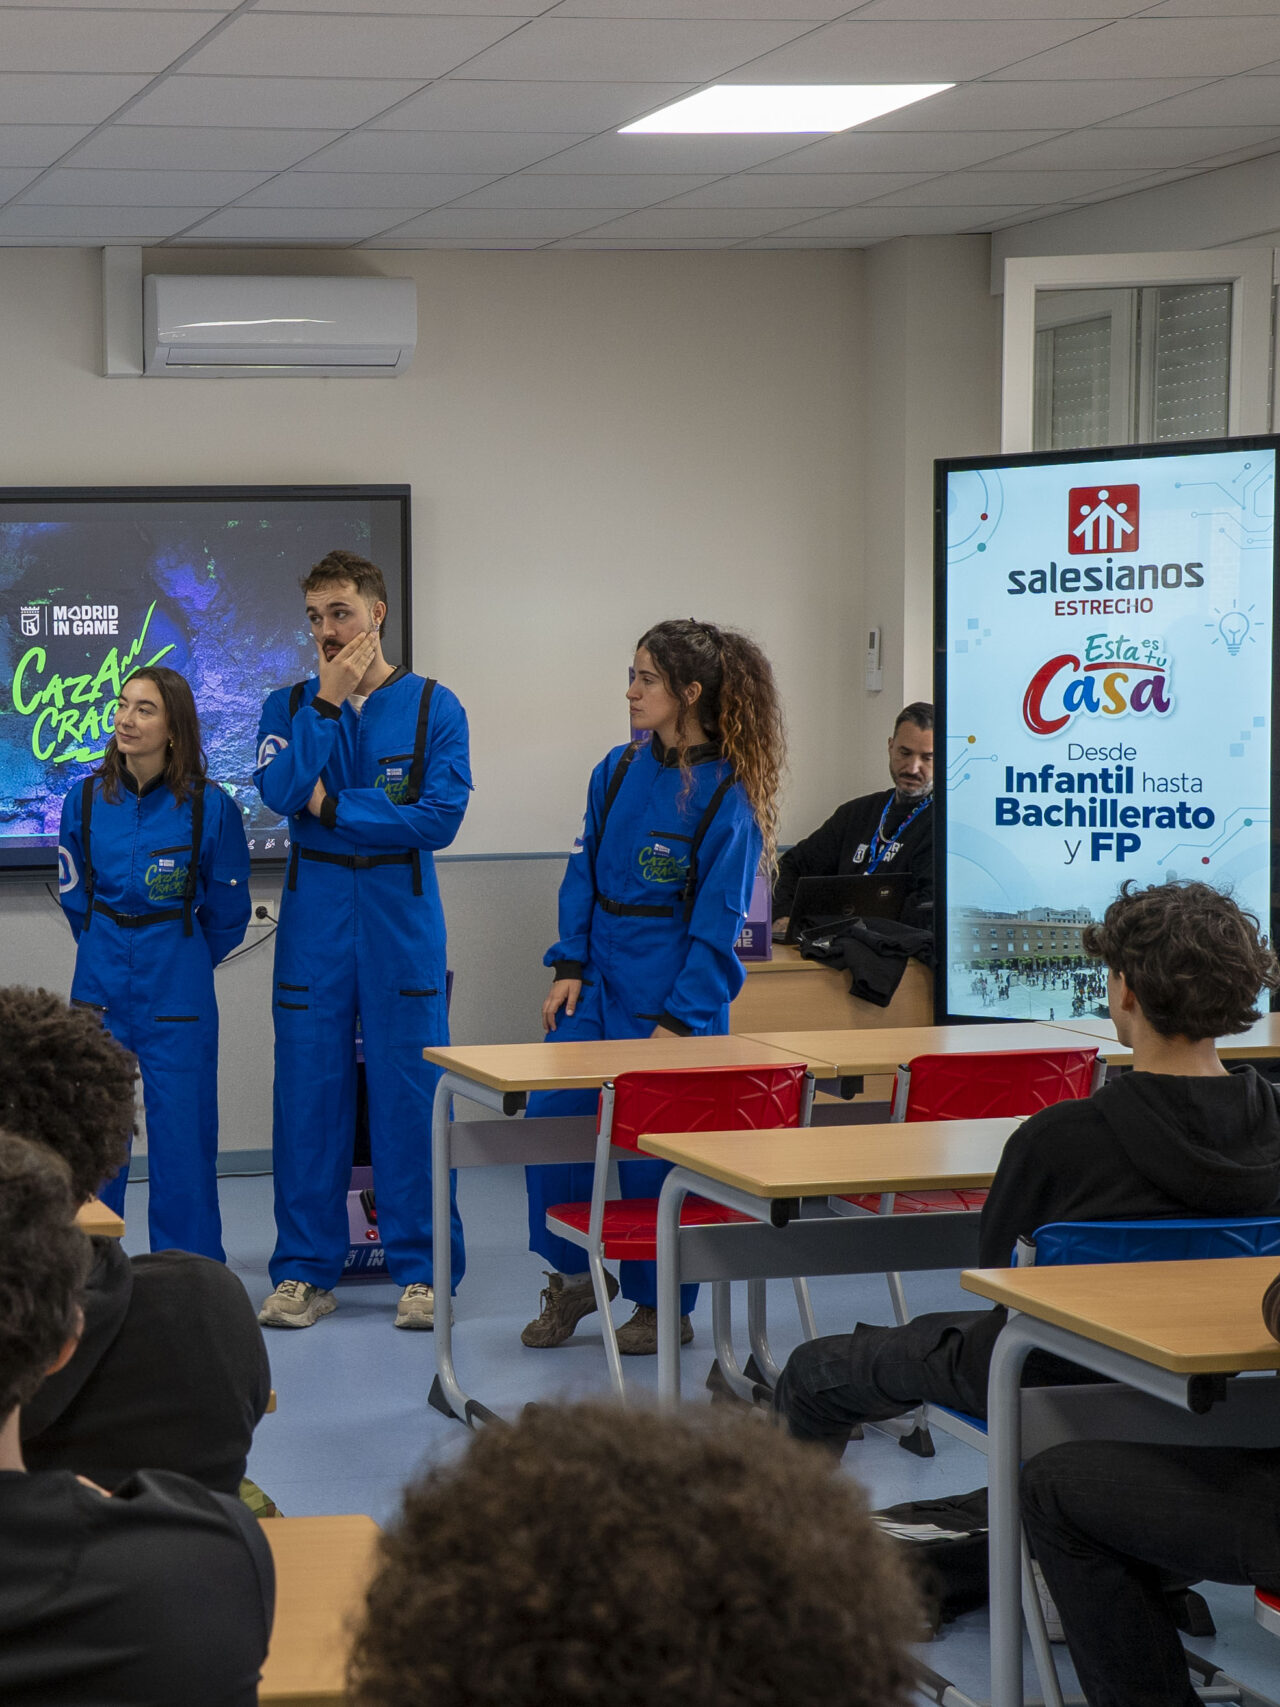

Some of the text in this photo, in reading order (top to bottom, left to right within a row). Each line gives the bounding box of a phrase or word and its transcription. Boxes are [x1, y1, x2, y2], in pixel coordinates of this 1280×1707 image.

[1007, 557, 1205, 595] salesianos
[53, 605, 119, 620] MADRID
[1054, 597, 1154, 617] ESTRECHO
[53, 620, 119, 635] IN GAME
[1084, 633, 1160, 662] Esta es
[1144, 650, 1168, 668] tu
[1022, 654, 1172, 735] Casa
[32, 699, 119, 760] CRAC
[1067, 743, 1137, 761] Desde
[1005, 764, 1203, 795] Infantil hasta
[995, 797, 1216, 830] Bachillerato
[1064, 832, 1142, 866] y FP
